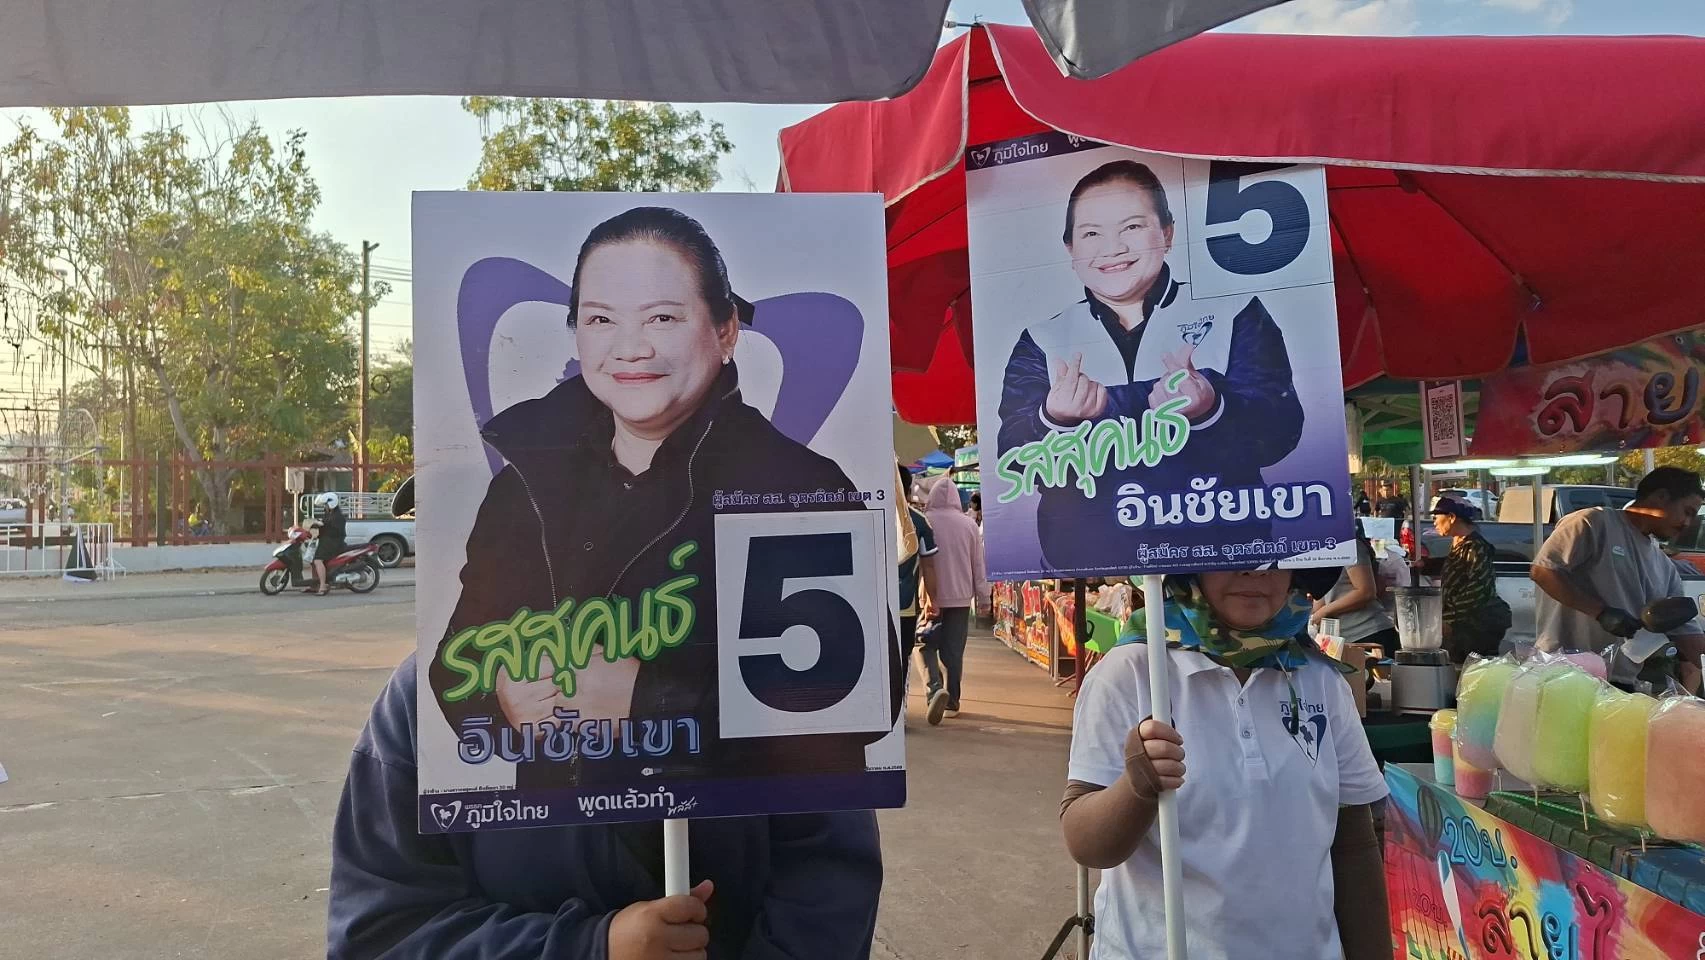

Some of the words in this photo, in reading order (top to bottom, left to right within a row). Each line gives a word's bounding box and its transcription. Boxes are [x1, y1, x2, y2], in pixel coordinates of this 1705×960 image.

[994, 142, 1048, 164] ภูมิใจไทย
[1205, 160, 1311, 276] 5
[1537, 366, 1699, 436] สาย
[996, 369, 1191, 504] รสสุคนธ์
[712, 489, 760, 509] ผู้สมัคร
[763, 492, 785, 505] สส.
[789, 488, 844, 507] อุตรดิตถ์
[848, 490, 872, 502] เขต
[876, 489, 885, 501] 3
[1116, 476, 1333, 528] อินชัยเขา
[1136, 543, 1187, 564] ผู้สมัคร
[1192, 544, 1217, 558] สส.
[1222, 537, 1287, 560] อุตรดิตถ์
[1291, 539, 1321, 552] เขต
[1325, 537, 1337, 551] 3
[442, 540, 699, 701] รสสุคนธ์
[738, 532, 865, 713] 5
[457, 706, 701, 765] อินชัยเขา
[465, 799, 549, 829] ภูมิใจไทย
[577, 785, 675, 818] พูดแล้วทำ
